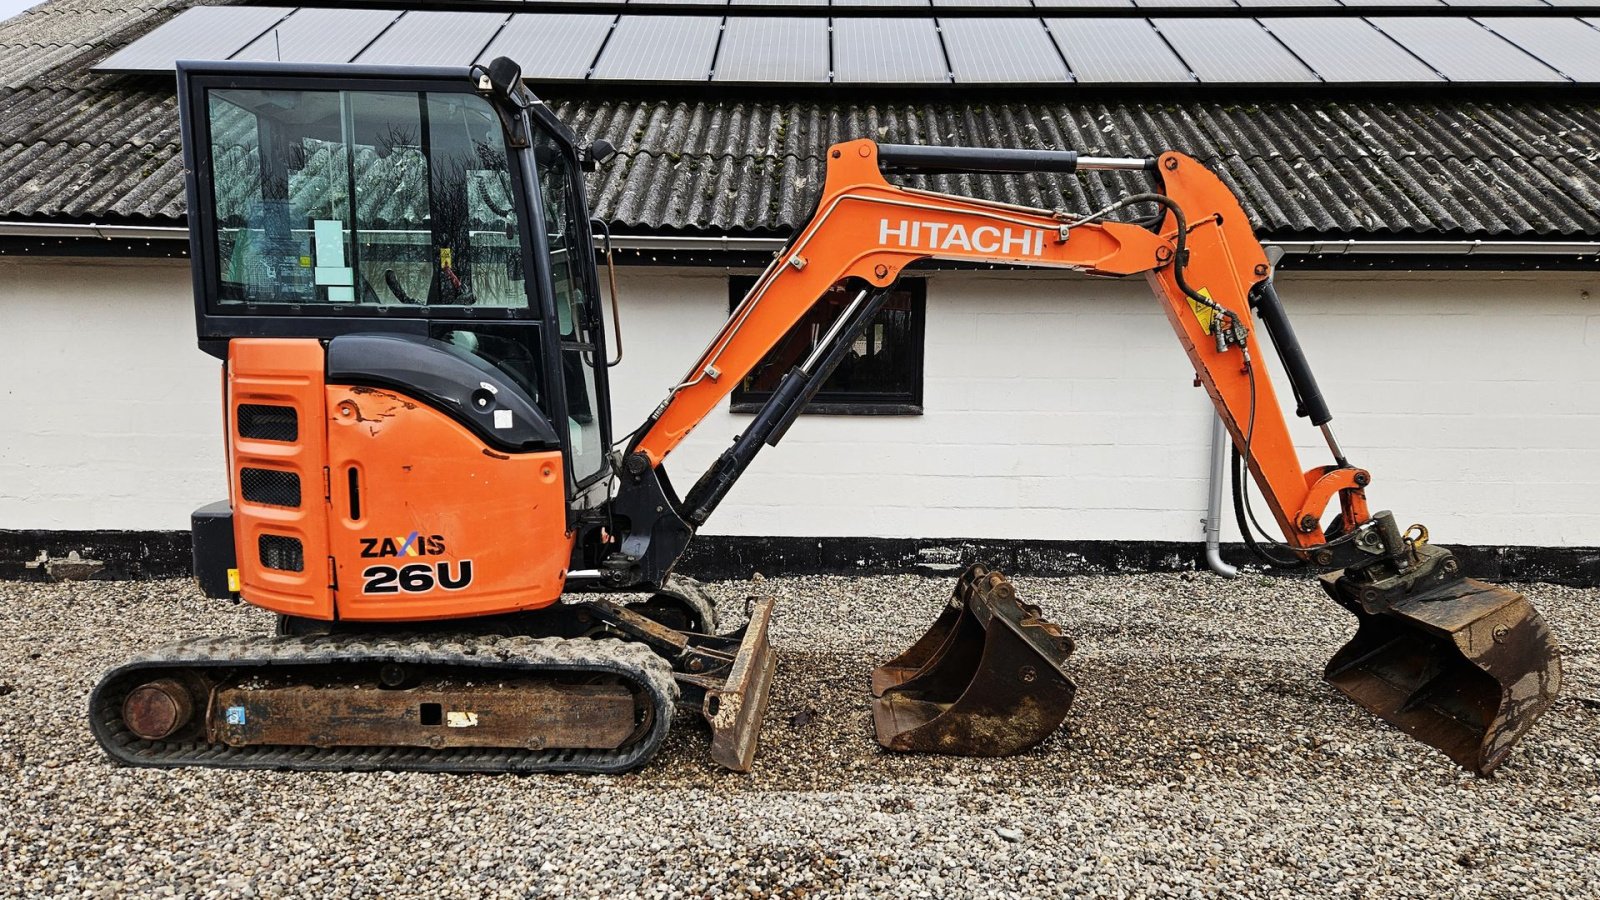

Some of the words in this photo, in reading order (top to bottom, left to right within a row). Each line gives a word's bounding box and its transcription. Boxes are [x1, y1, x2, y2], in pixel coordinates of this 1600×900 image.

[879, 218, 1044, 256] HITACHI
[360, 531, 446, 558] ZAXIS
[362, 560, 473, 595] 26U
